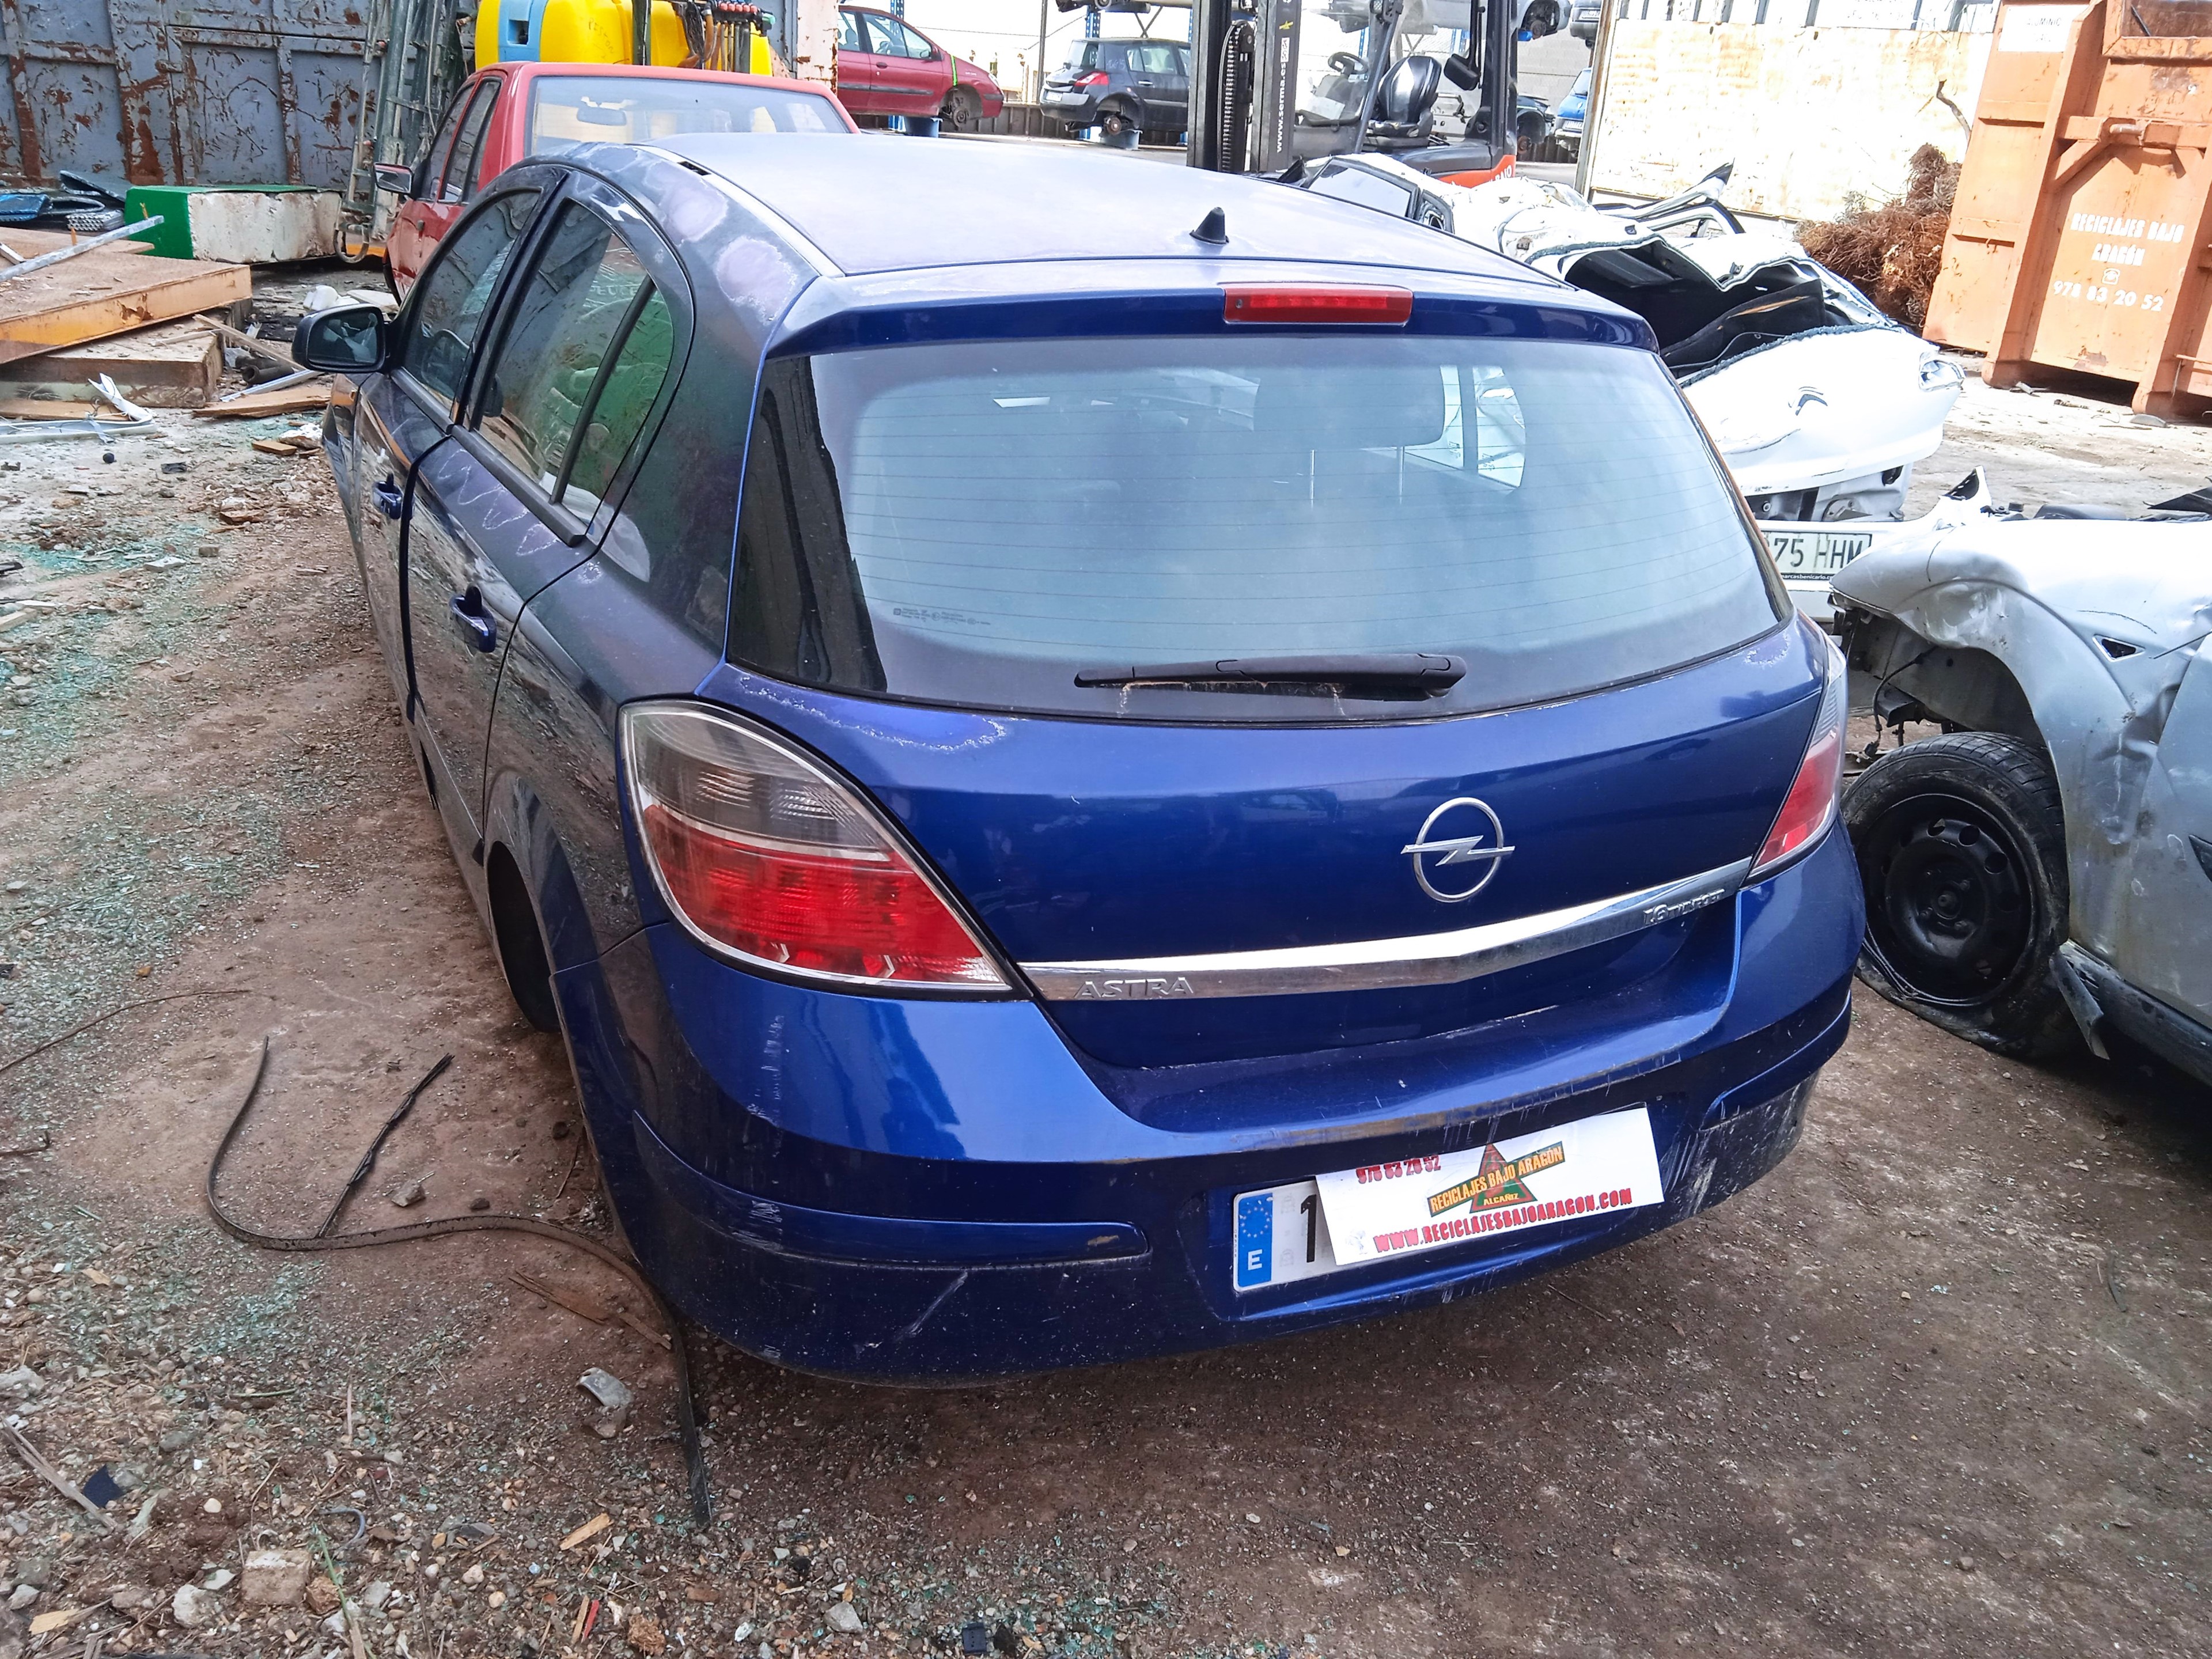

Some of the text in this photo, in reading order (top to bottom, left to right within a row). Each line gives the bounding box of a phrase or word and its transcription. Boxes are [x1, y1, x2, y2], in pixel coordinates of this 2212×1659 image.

[2026, 17, 2062, 26] AUMINIO
[1277, 62, 1286, 153] www.serma.es
[2070, 213, 2185, 244] RECICLAJES BAJO
[2091, 243, 2146, 266] ARAGÓN
[2053, 281, 2164, 312] 978 83 20 52
[1764, 537, 1804, 567] 75
[1074, 977, 1194, 998] ASTRA
[1423, 1154, 1441, 1172] 52
[1430, 1146, 1564, 1214] RECICLAJES BAJO ARAGÓN
[1483, 1192, 1520, 1206] ALCAÑIZ
[1300, 1194, 1317, 1263] 1
[1373, 1188, 1633, 1253] WWW.RECICLAJESBAJOARAGON.COM
[1247, 1249, 1263, 1271] E
